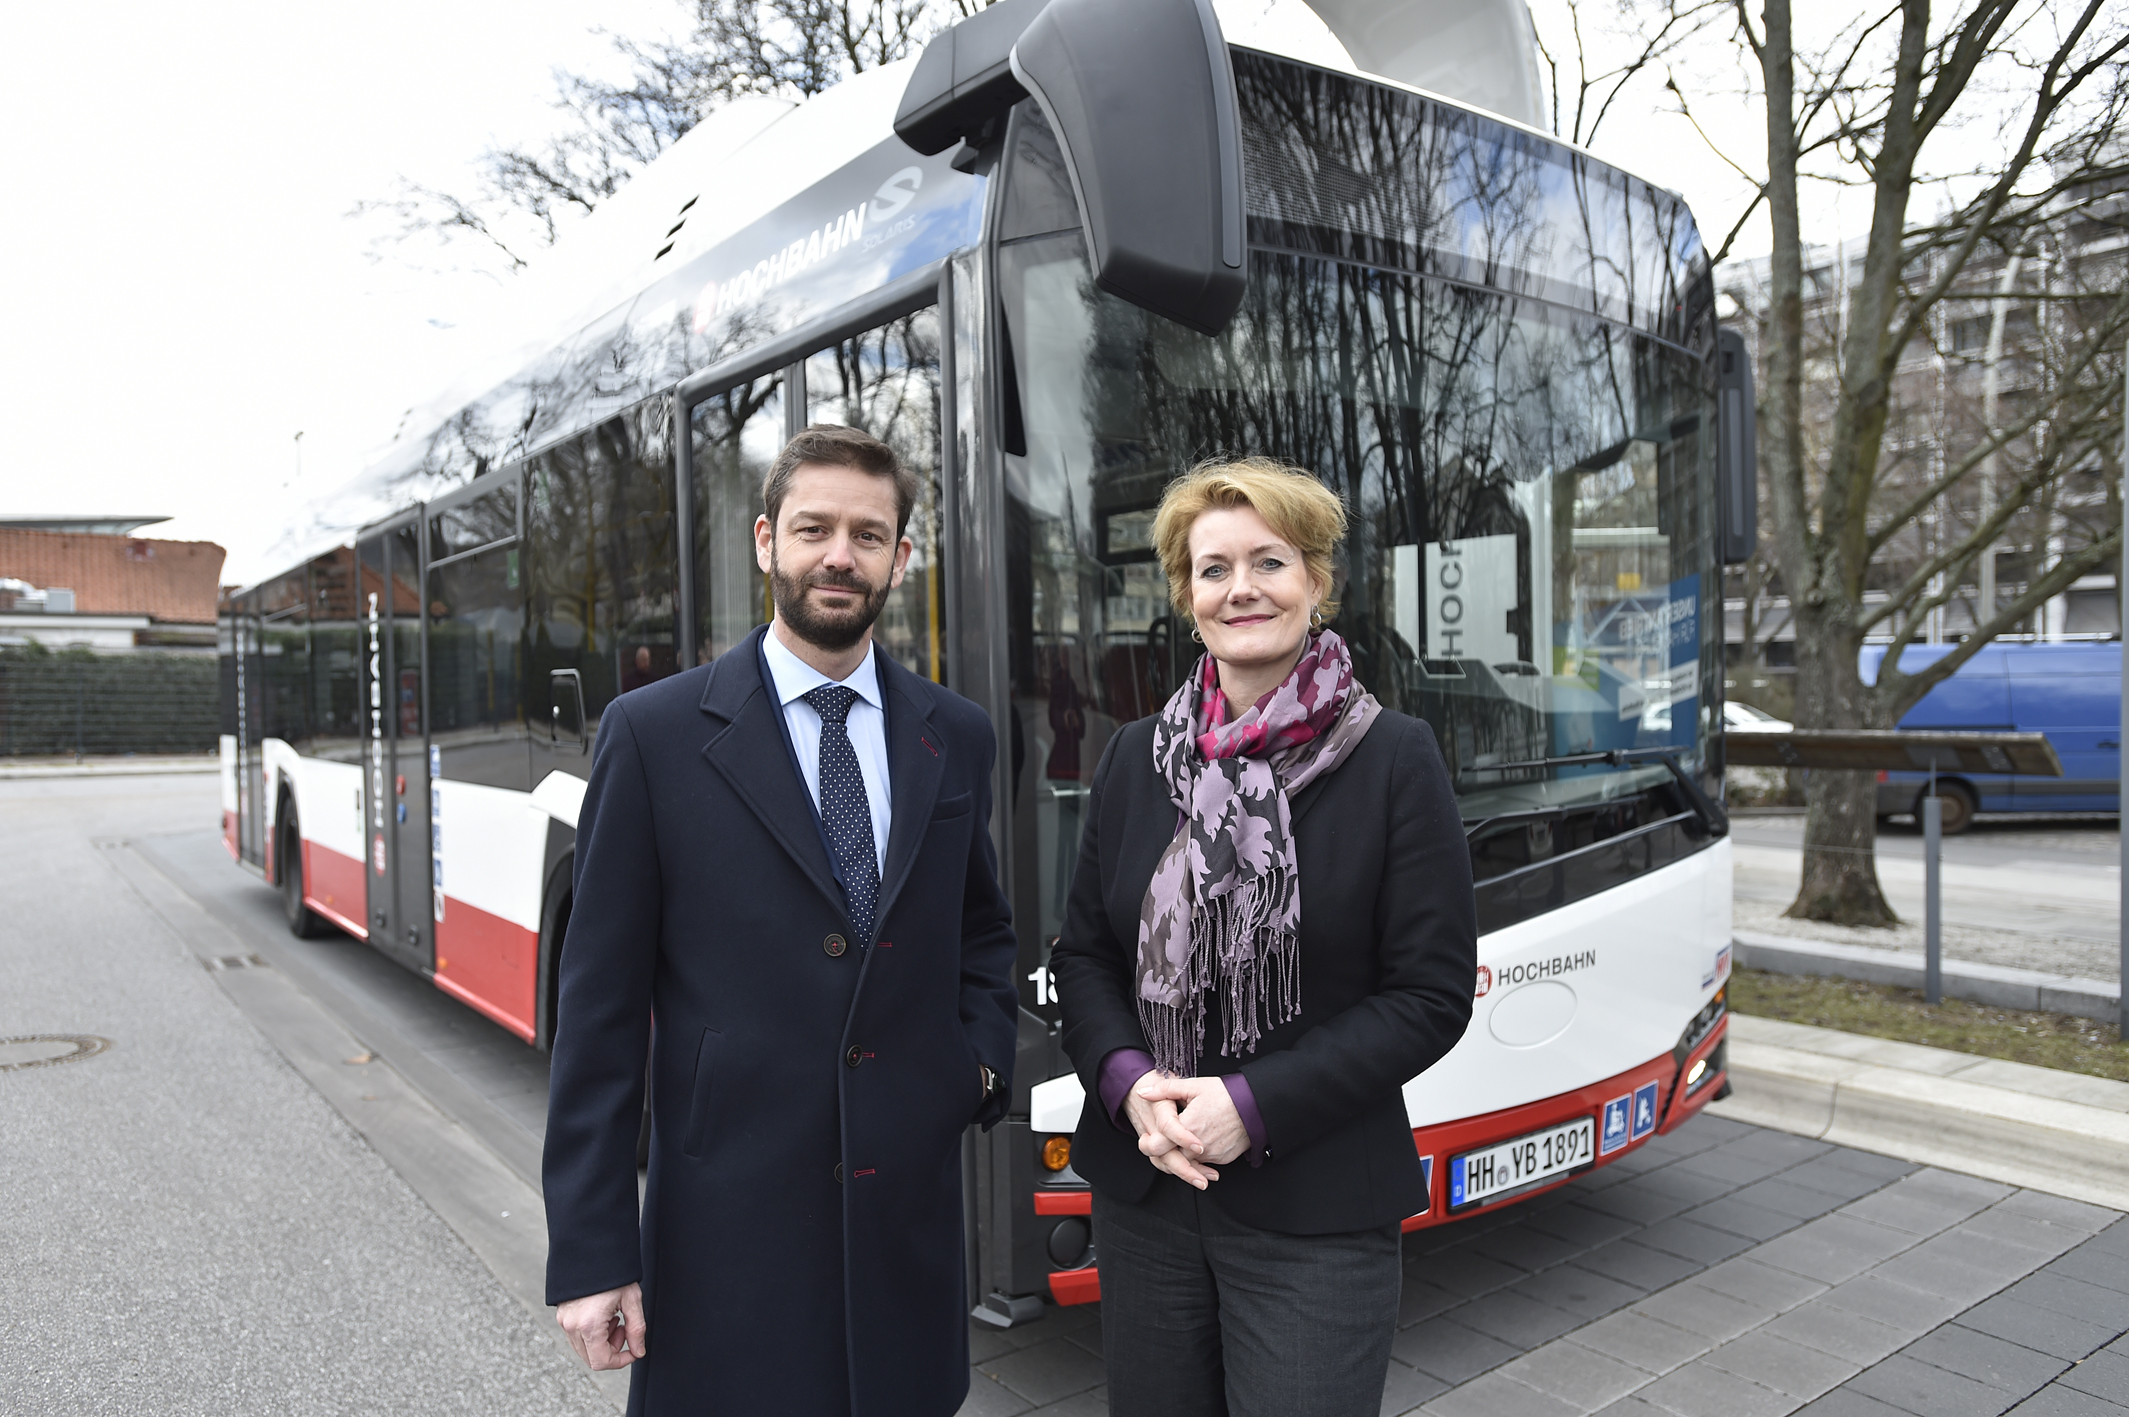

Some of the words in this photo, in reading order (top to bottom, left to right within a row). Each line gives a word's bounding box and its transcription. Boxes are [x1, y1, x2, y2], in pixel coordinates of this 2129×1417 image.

[716, 202, 867, 315] HOCHBAHN
[861, 213, 916, 253] SOLARIS
[1498, 949, 1596, 986] HOCHBAHN
[1468, 1154, 1495, 1195] HH
[1512, 1142, 1537, 1179] YB
[1543, 1125, 1590, 1170] 1891
